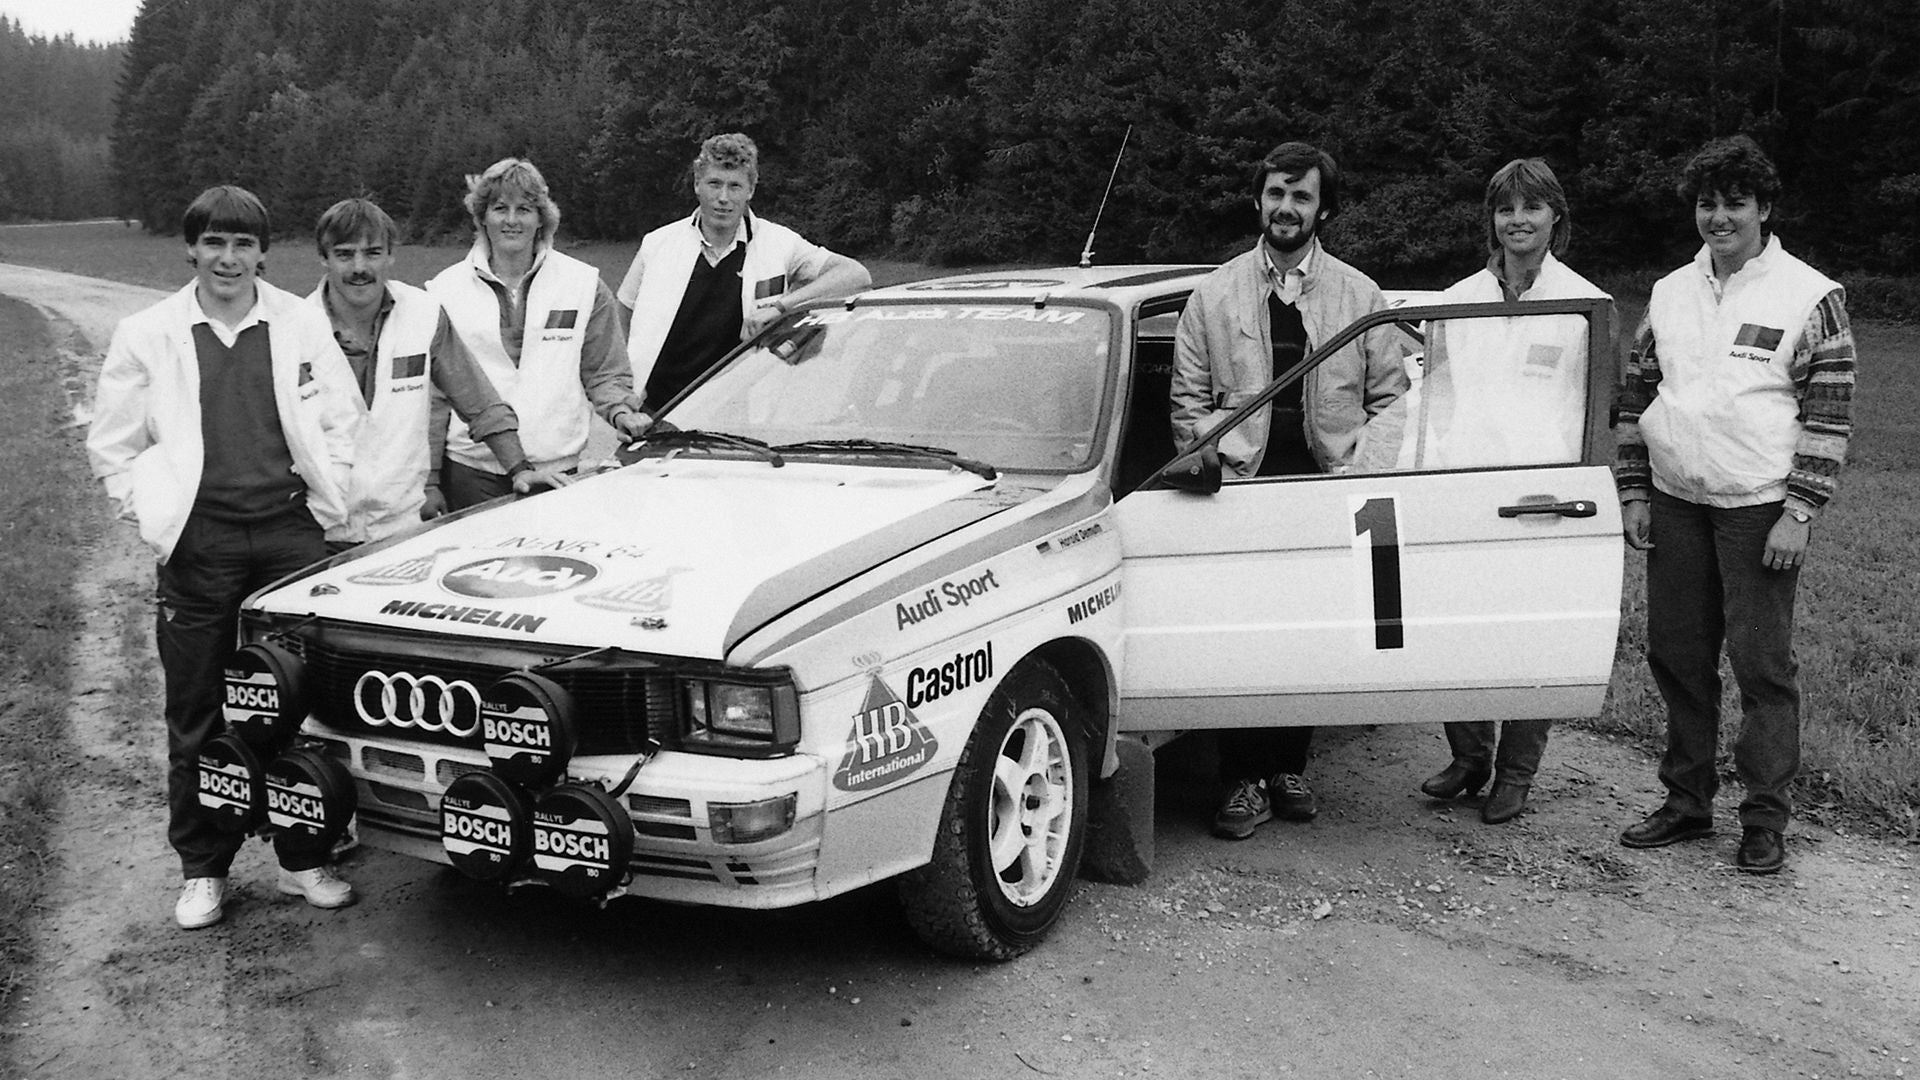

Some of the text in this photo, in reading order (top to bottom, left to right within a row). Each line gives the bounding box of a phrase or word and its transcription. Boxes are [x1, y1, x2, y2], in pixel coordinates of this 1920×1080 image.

[854, 308, 948, 321] Audi
[953, 307, 1086, 325] TEAM
[1748, 353, 1771, 364] Sport
[449, 559, 588, 589] Audi
[1354, 498, 1404, 649] 1
[896, 568, 1000, 631] Audi Sport
[379, 600, 547, 633] MICHELIN
[906, 640, 993, 709] Castrol
[226, 684, 280, 709] BOSCH
[480, 700, 508, 713] RALLYE
[483, 718, 551, 747] BOSCH
[852, 700, 912, 765] HB
[847, 748, 925, 787] international
[199, 770, 250, 802] BOSCH
[267, 788, 325, 820] BOSCH
[444, 796, 471, 809] RALLYE
[534, 811, 564, 824] RALLYE
[444, 812, 512, 846] BOSCH
[534, 828, 610, 860] BOSCH
[586, 868, 600, 877] 180
